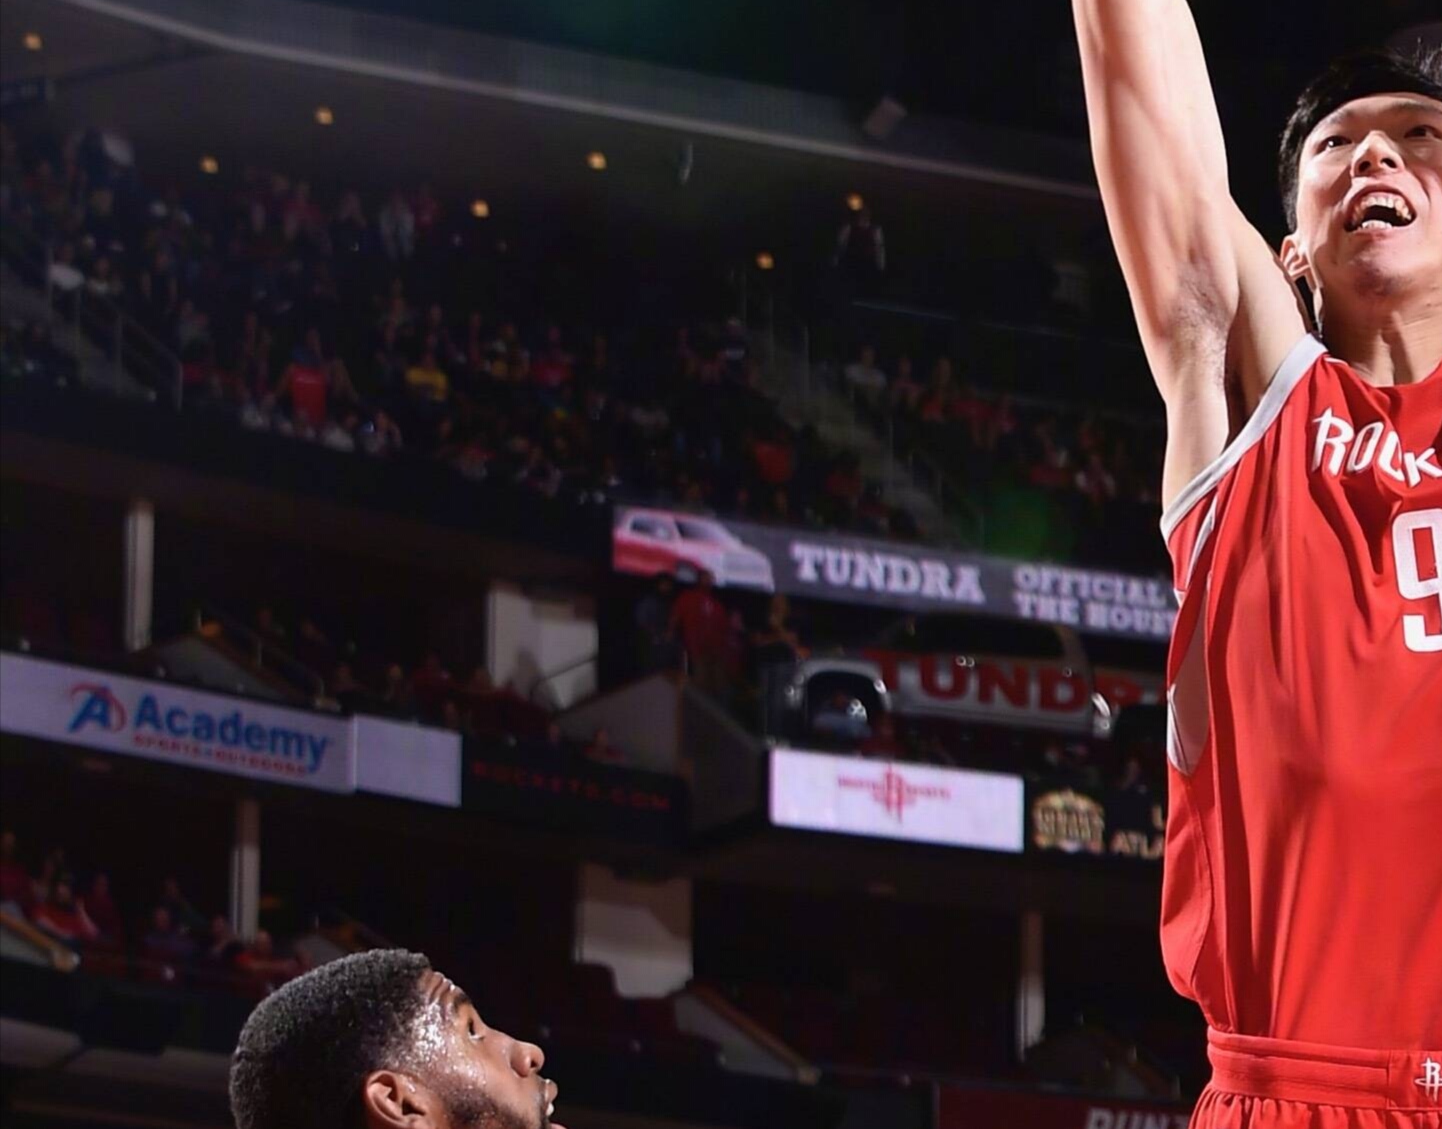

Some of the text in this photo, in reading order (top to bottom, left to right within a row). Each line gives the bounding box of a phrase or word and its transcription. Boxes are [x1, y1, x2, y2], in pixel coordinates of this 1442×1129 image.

[791, 541, 985, 605] TUNDRA
[1013, 567, 1167, 607] OFFICIAL
[1014, 592, 1080, 625] THE
[134, 693, 328, 773] Academy
